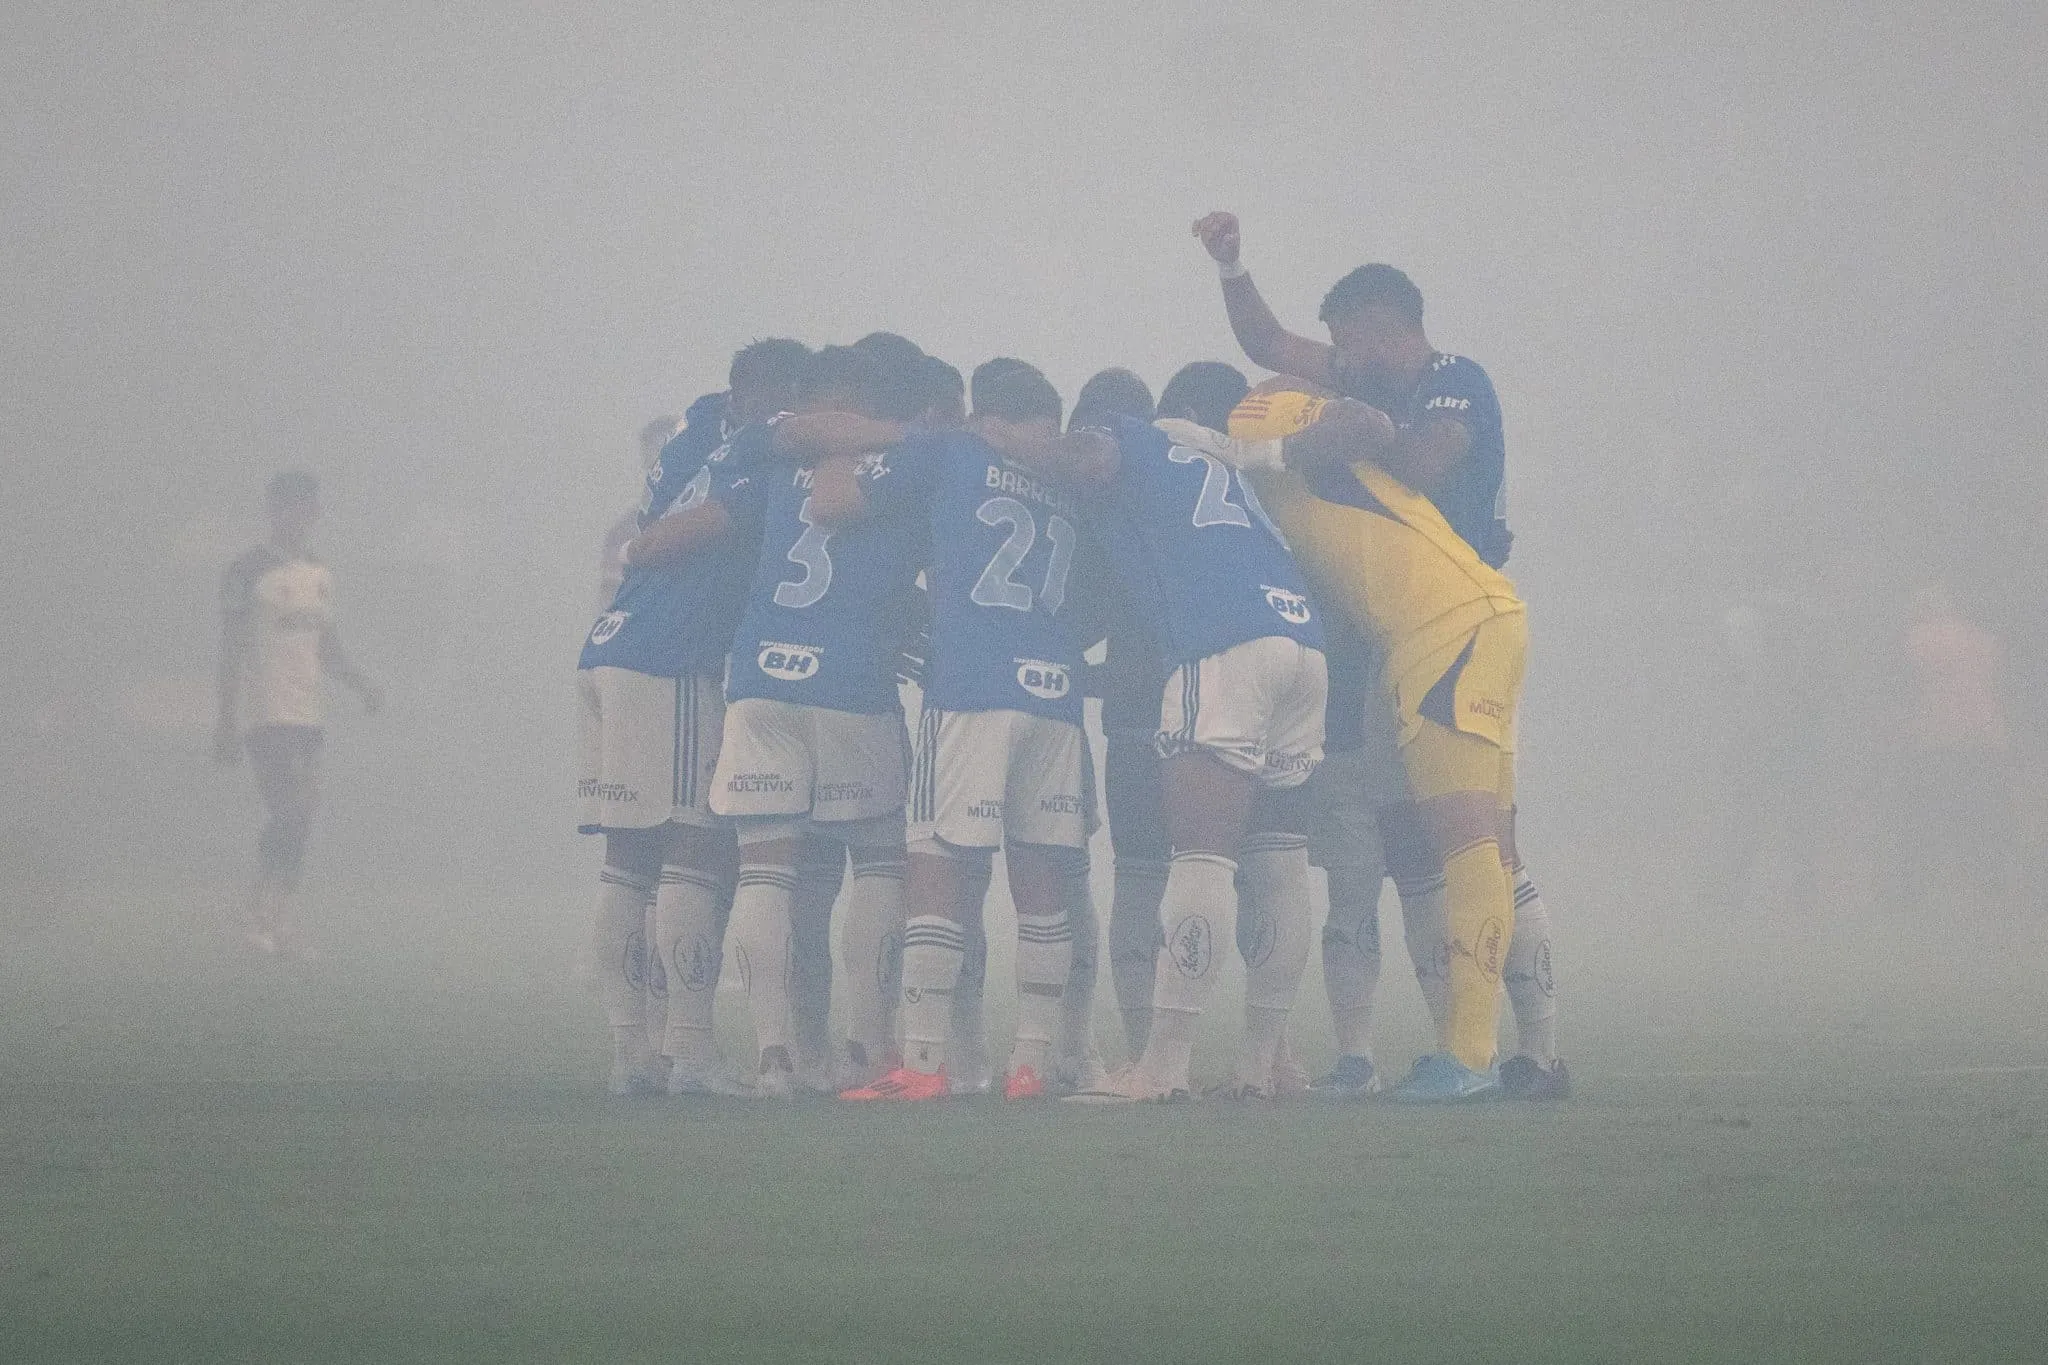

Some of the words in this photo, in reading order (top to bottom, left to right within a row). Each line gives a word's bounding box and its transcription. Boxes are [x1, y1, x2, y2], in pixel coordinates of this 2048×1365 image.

[773, 496, 833, 608] 3
[970, 497, 1077, 616] 21
[1272, 596, 1305, 619] BH
[763, 651, 813, 674] BH
[1024, 669, 1065, 692] BH
